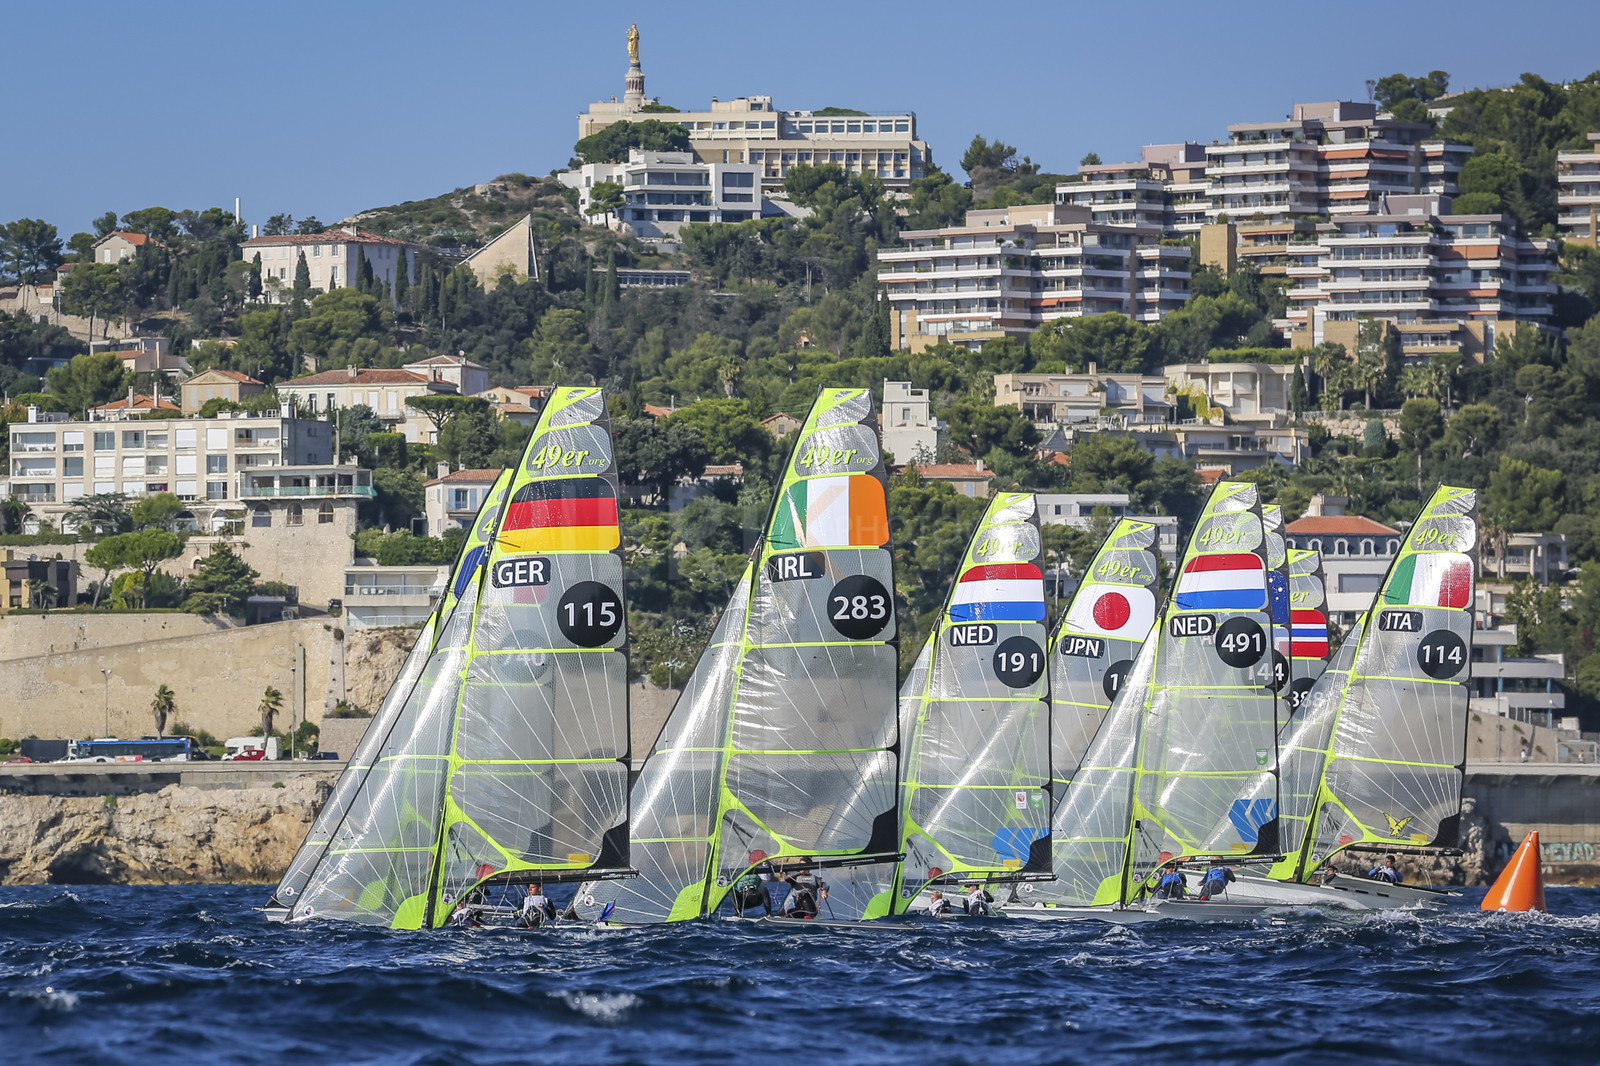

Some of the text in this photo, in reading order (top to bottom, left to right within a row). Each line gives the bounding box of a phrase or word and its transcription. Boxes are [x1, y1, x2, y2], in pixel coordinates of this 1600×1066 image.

[497, 560, 545, 585] GER
[777, 556, 813, 579] IRL
[563, 601, 616, 627] 115
[833, 595, 886, 620] 283
[1172, 616, 1213, 635] NED
[1386, 612, 1412, 630] ITA
[952, 626, 994, 645] NED
[1221, 632, 1261, 653] 491
[1065, 638, 1100, 657] JPN
[1422, 644, 1462, 665] 114
[997, 652, 1038, 673] 191
